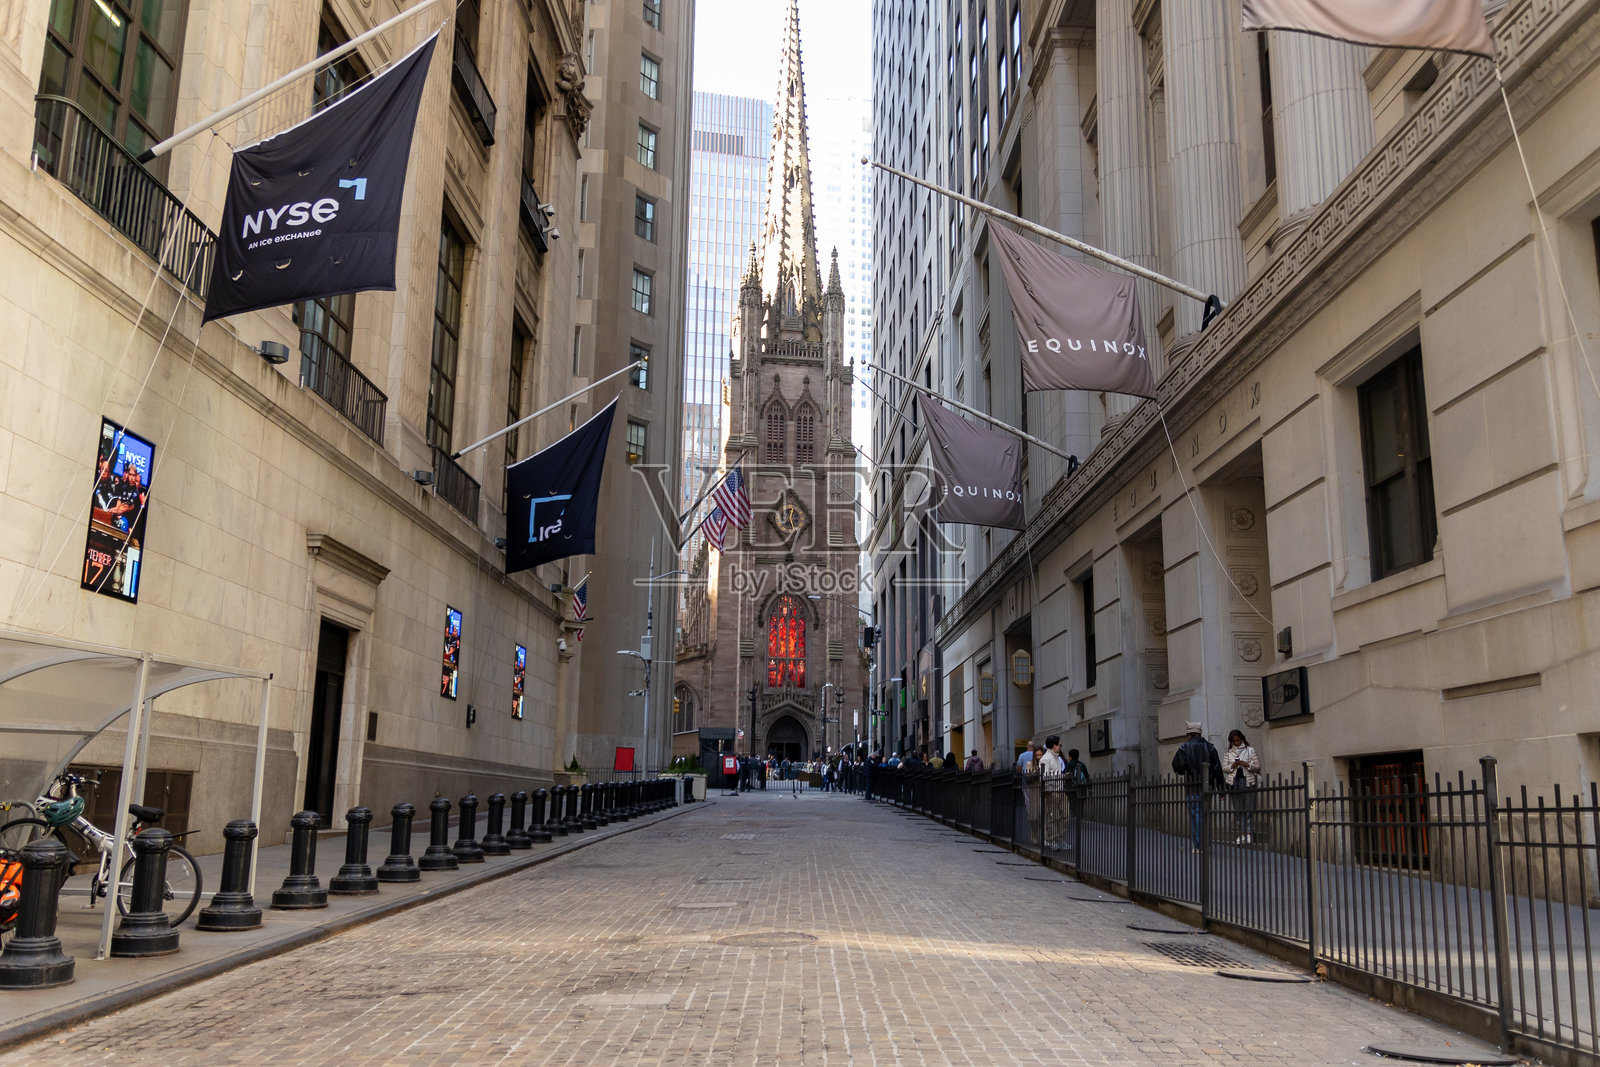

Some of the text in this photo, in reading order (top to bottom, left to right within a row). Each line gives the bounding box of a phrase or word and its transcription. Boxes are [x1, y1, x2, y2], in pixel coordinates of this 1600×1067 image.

[248, 241, 259, 250] AN
[1027, 338, 1147, 361] EQUINOX
[125, 450, 146, 467] NYSE
[1113, 381, 1261, 522] EQUINOX
[941, 485, 1022, 504] EQUINOX
[83, 558, 104, 585] 17
